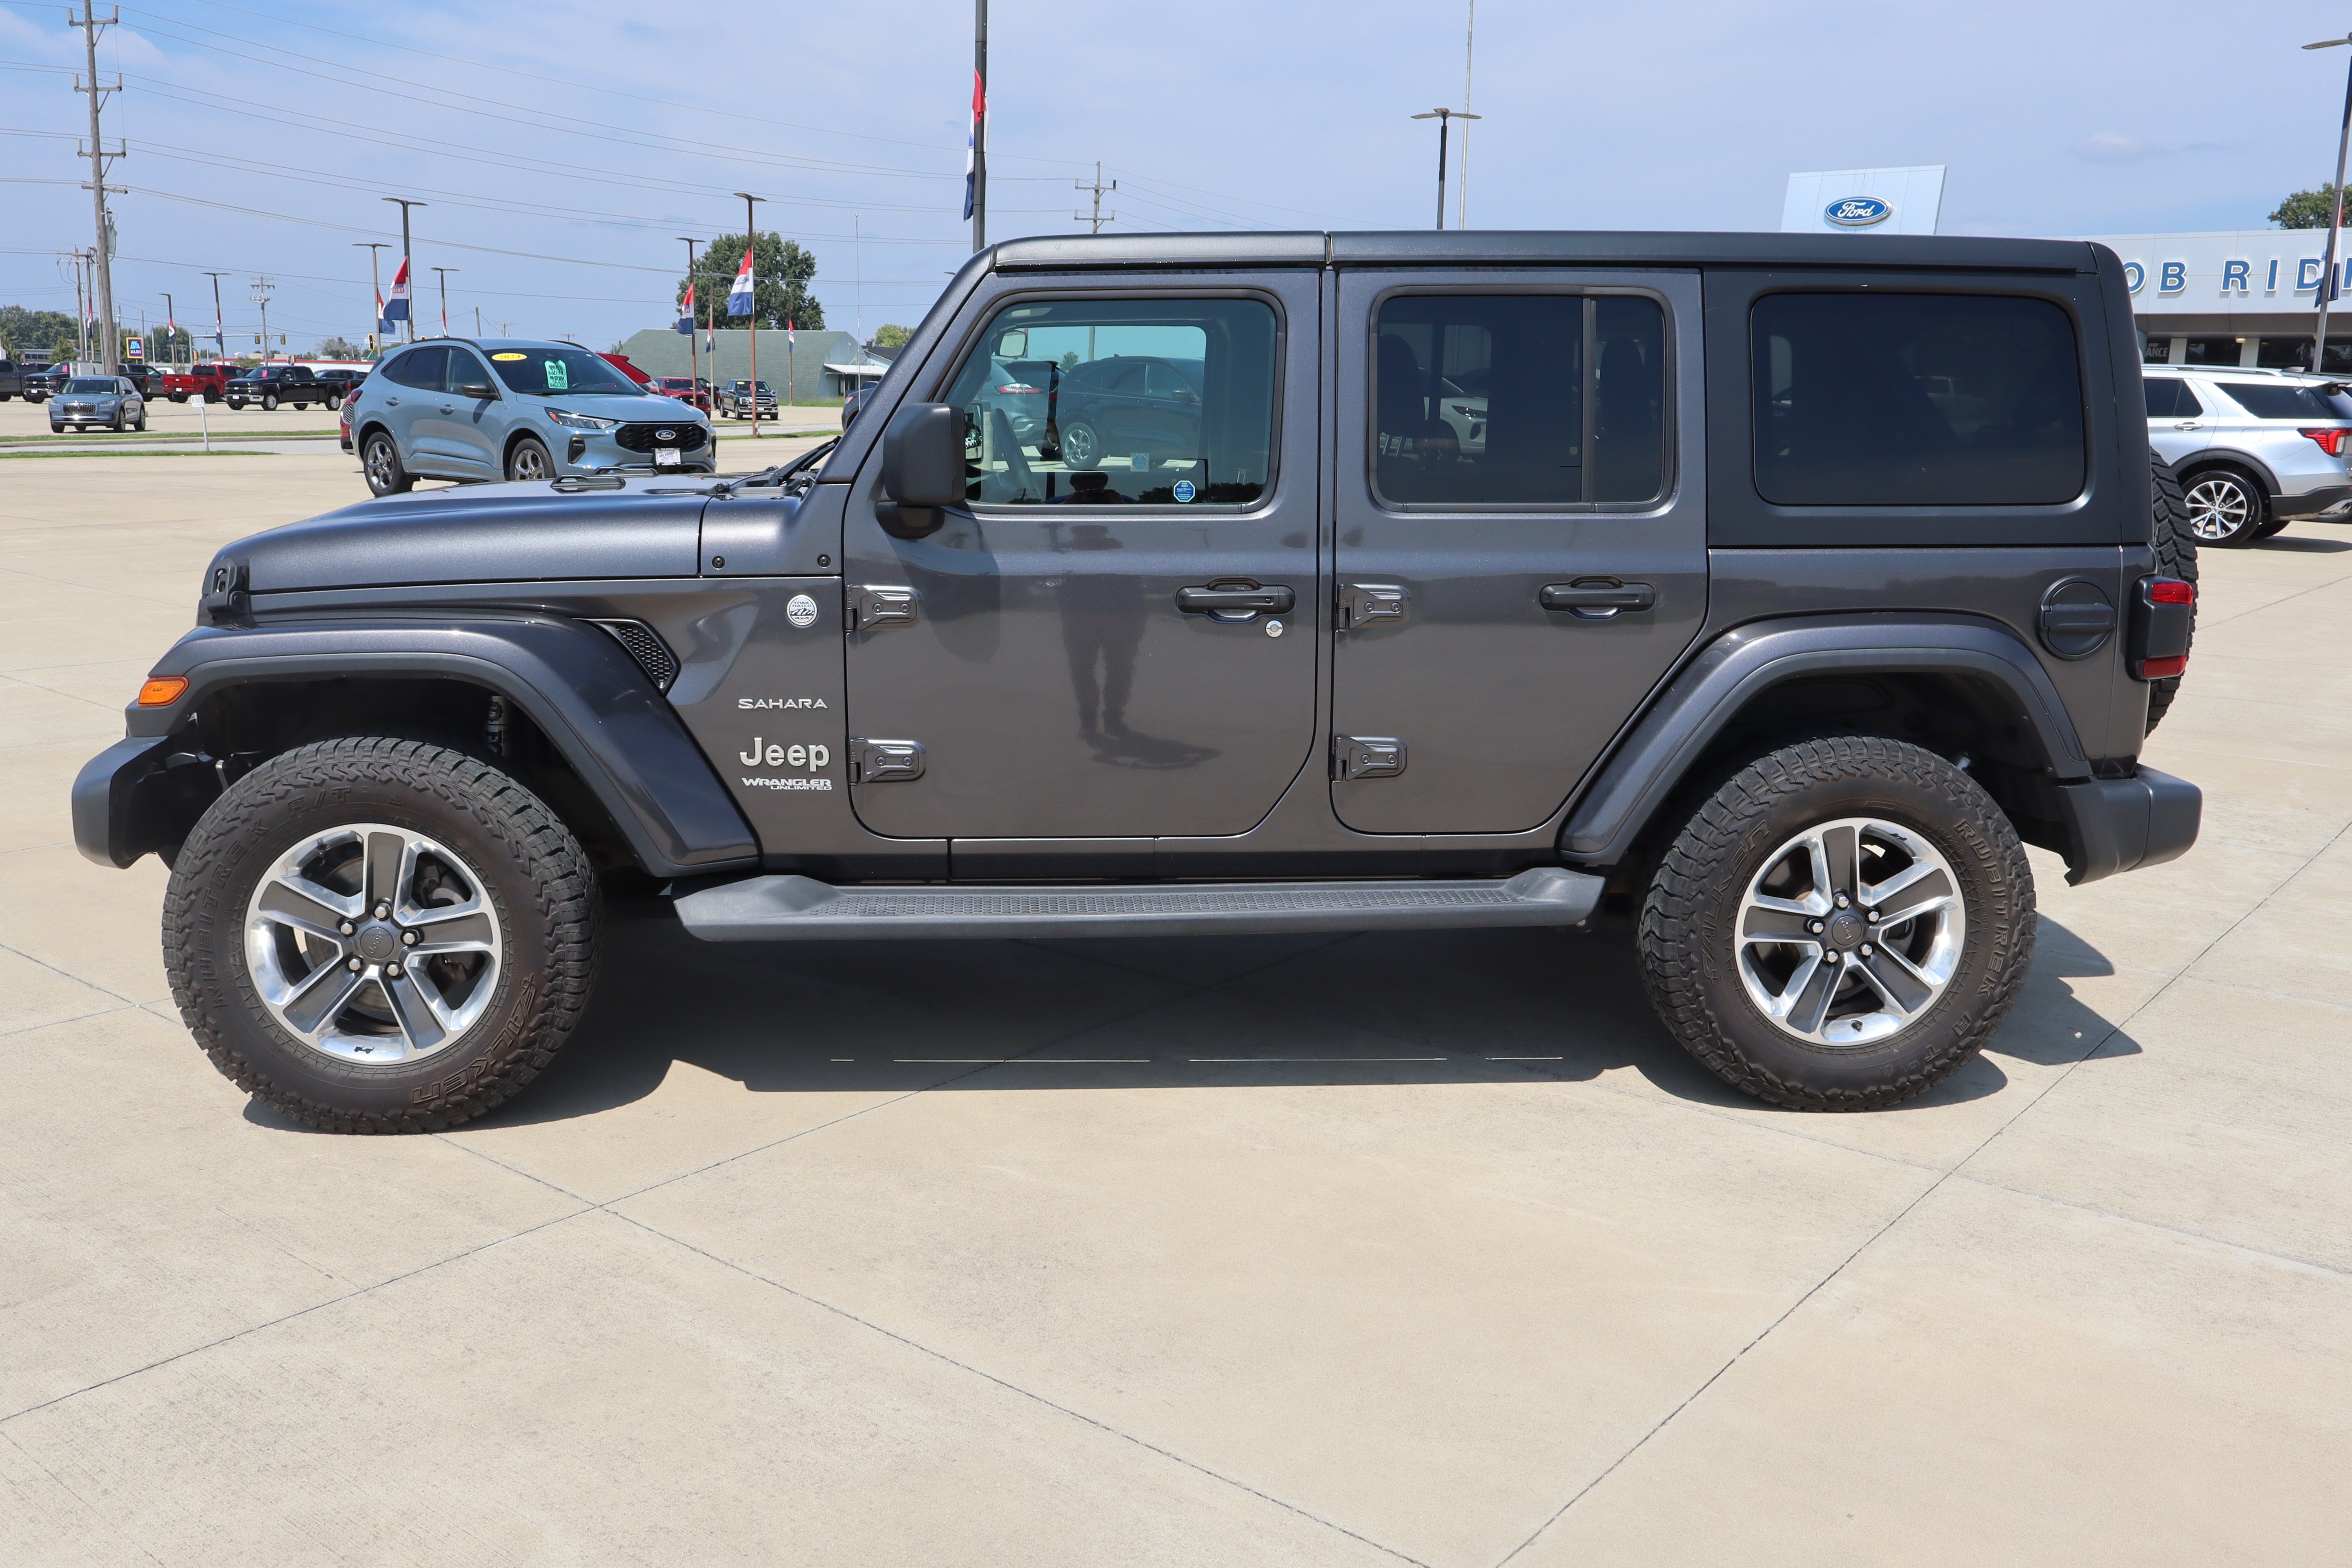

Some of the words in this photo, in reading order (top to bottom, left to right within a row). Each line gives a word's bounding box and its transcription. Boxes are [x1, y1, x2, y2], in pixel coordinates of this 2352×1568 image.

[1838, 202, 1875, 217] Ford
[2123, 261, 2187, 294] OB
[738, 699, 829, 709] SAHARA
[739, 737, 830, 772] Jeep
[741, 777, 832, 786] WRANGLER
[198, 817, 270, 1009] RUBITREK
[1953, 819, 2008, 1001] RUBITREK
